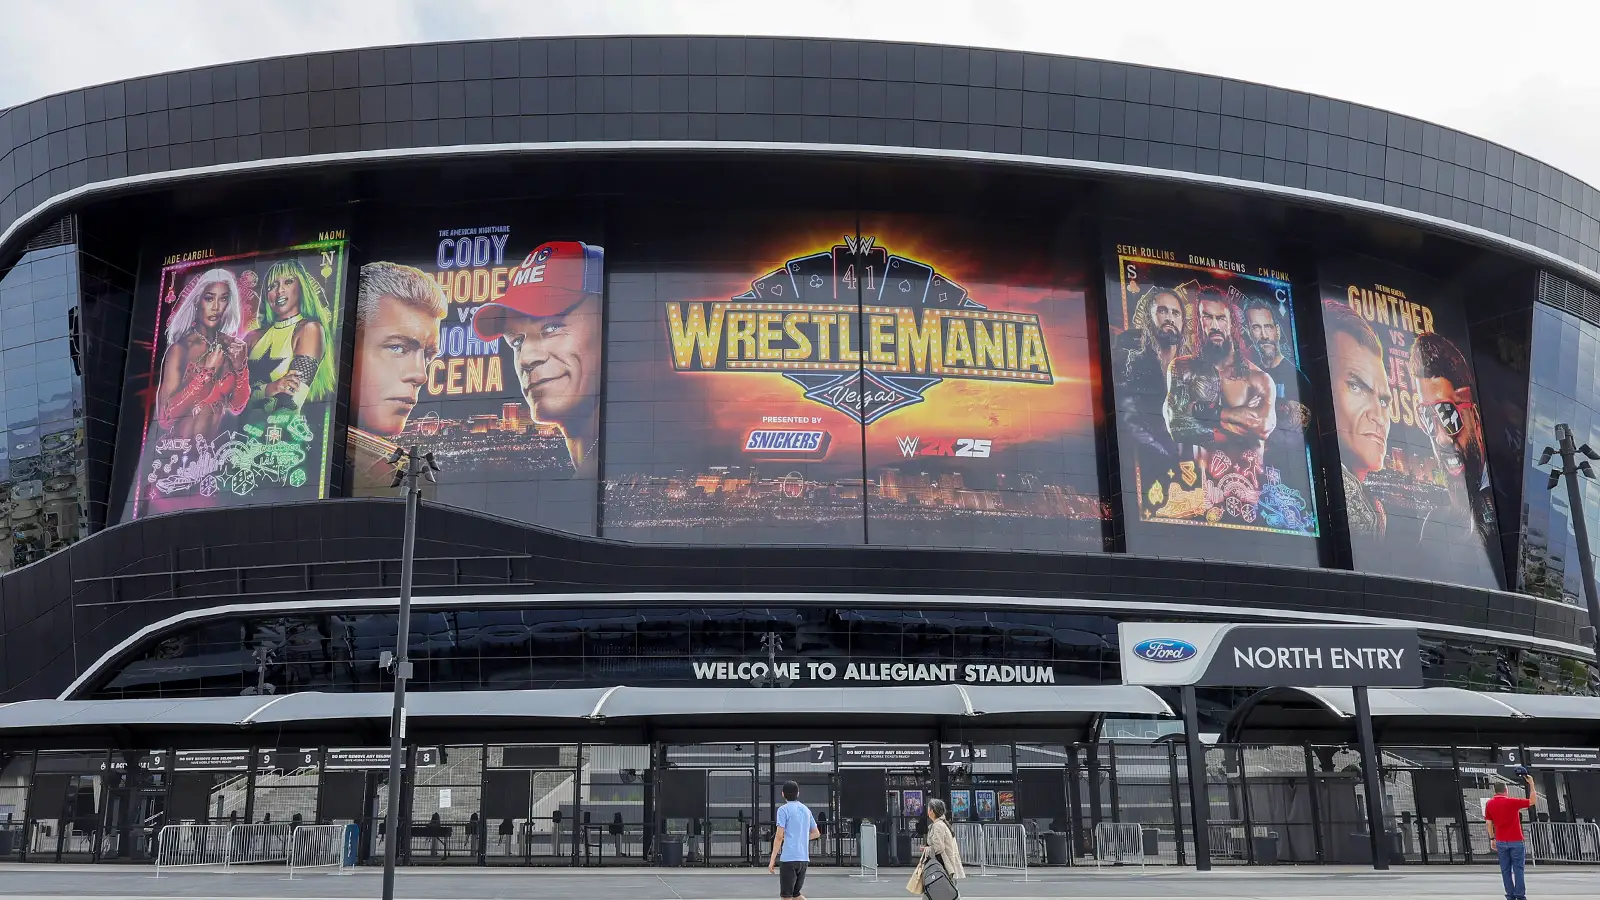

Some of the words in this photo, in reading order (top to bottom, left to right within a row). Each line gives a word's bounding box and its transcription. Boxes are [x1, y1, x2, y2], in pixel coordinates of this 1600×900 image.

[318, 229, 346, 242] NAOMI
[450, 227, 477, 236] AMERICAN
[478, 225, 510, 234] NIGHTMARE
[162, 251, 181, 266] JADE
[182, 248, 214, 262] CARGILL
[320, 250, 336, 266] N
[438, 234, 510, 269] CODY
[1116, 244, 1138, 256] SETH
[1140, 247, 1176, 261] ROLLINS
[1126, 264, 1138, 279] S
[1188, 254, 1216, 268] ROMAN
[1218, 259, 1246, 273] REIGNS
[512, 264, 546, 286] ME
[1258, 267, 1270, 278] CM
[1271, 269, 1290, 282] PUNK
[1275, 288, 1286, 302] C
[1347, 285, 1435, 334] GUNTHER
[1388, 329, 1406, 347] VS
[428, 356, 504, 396] CENA
[828, 386, 896, 410] Vegas
[762, 416, 810, 424] PRESENTED
[812, 416, 822, 424] BY
[748, 431, 821, 450] SNICKERS
[1146, 642, 1184, 660] Ford
[1234, 646, 1322, 669] NORTH
[1330, 648, 1405, 670] ENTRY
[692, 662, 800, 680] WELCOME
[806, 662, 836, 681] TO
[843, 662, 958, 682] ALLEGIANT
[964, 664, 1056, 684] STADIUM
[154, 756, 160, 765] 9
[264, 754, 271, 764] 9
[304, 754, 312, 764] 8
[422, 753, 430, 762] 8
[816, 750, 824, 760] 7
[948, 750, 954, 760] 7
[1508, 752, 1515, 762] 6
